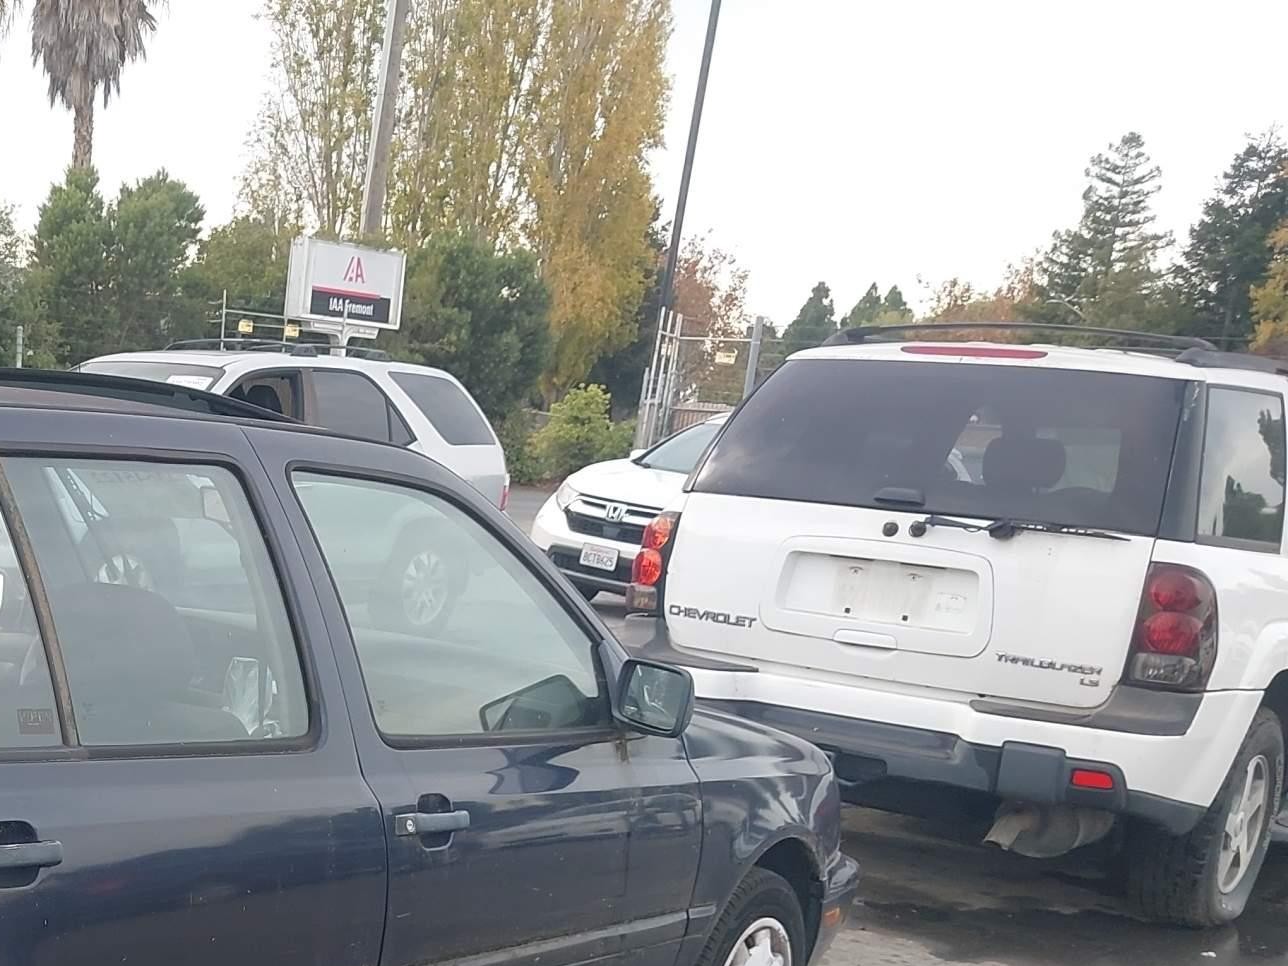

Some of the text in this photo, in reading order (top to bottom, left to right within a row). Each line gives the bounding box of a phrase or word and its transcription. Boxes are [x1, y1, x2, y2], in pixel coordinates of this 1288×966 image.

[328, 297, 374, 316] IAA Fremont
[669, 604, 757, 629] CHEVROLET
[995, 652, 1103, 675] TRAILBLAZER
[1079, 678, 1100, 688] LS
